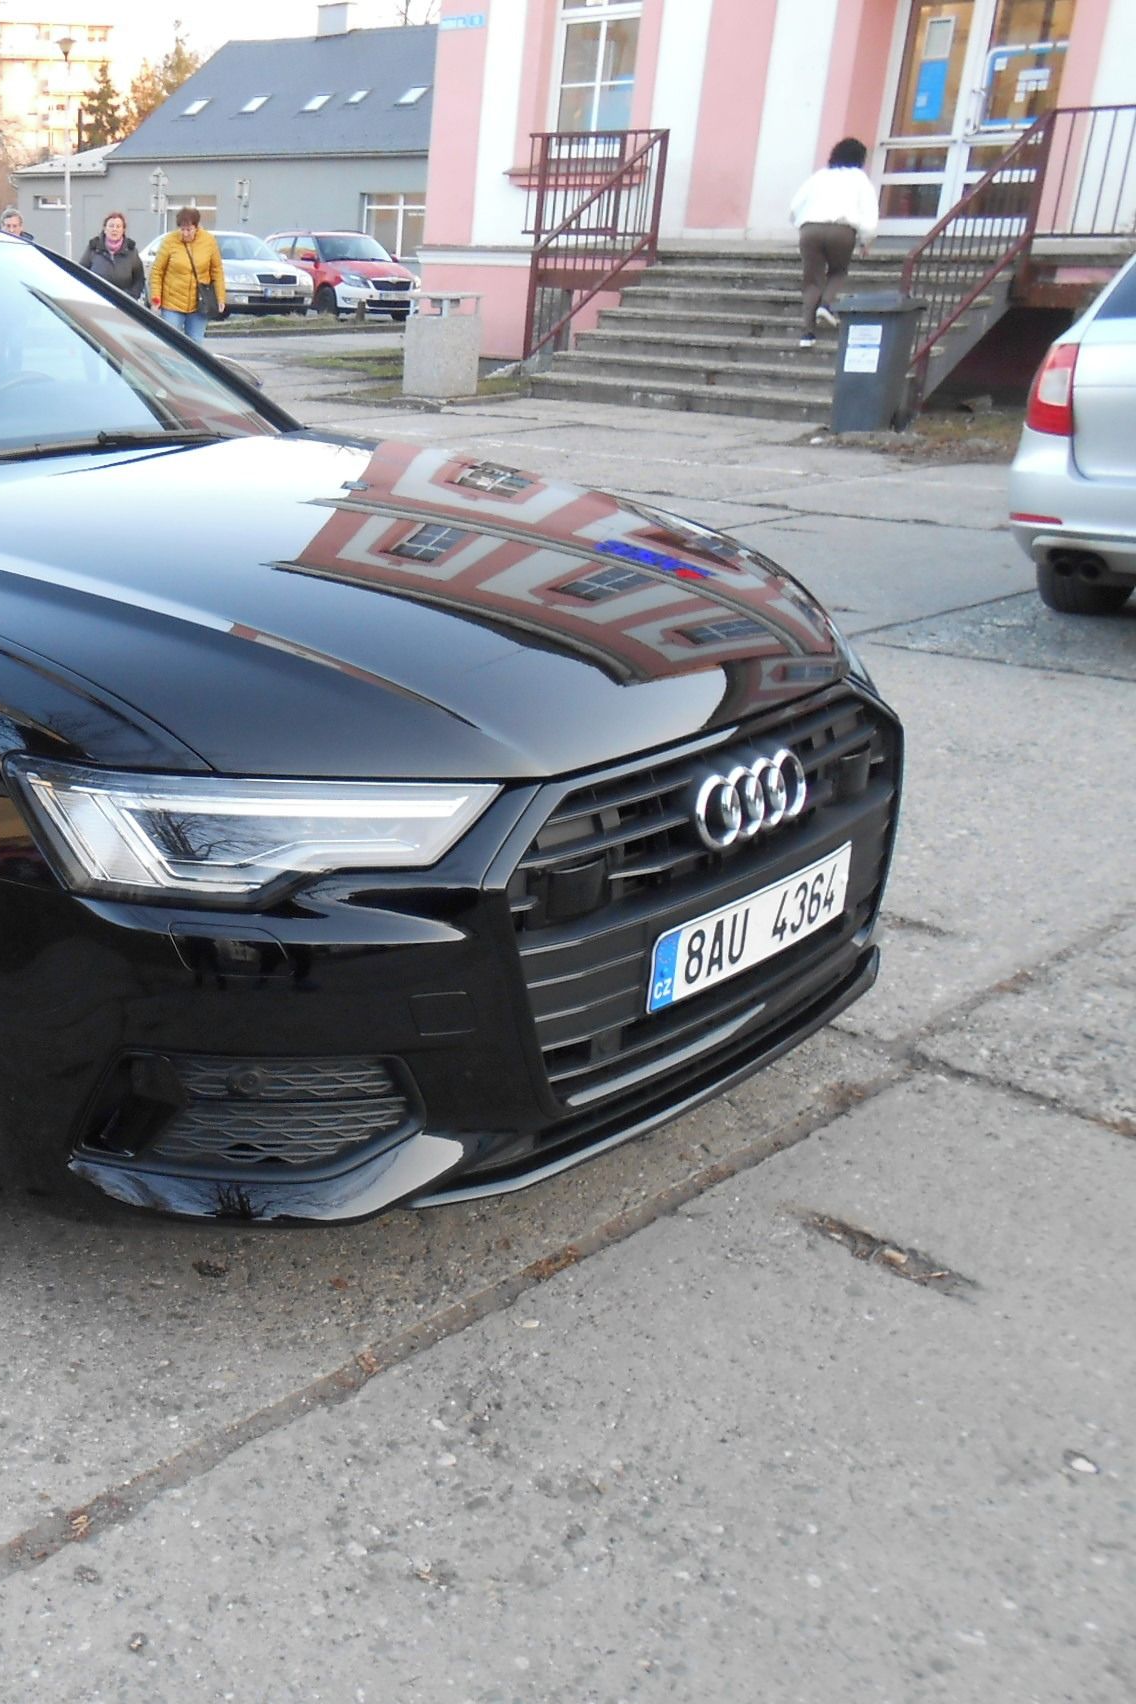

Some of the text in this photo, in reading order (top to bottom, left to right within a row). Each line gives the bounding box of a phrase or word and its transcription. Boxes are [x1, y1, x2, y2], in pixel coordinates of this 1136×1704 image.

[685, 863, 837, 984] 8AU 4364
[653, 977, 672, 1000] CZ
